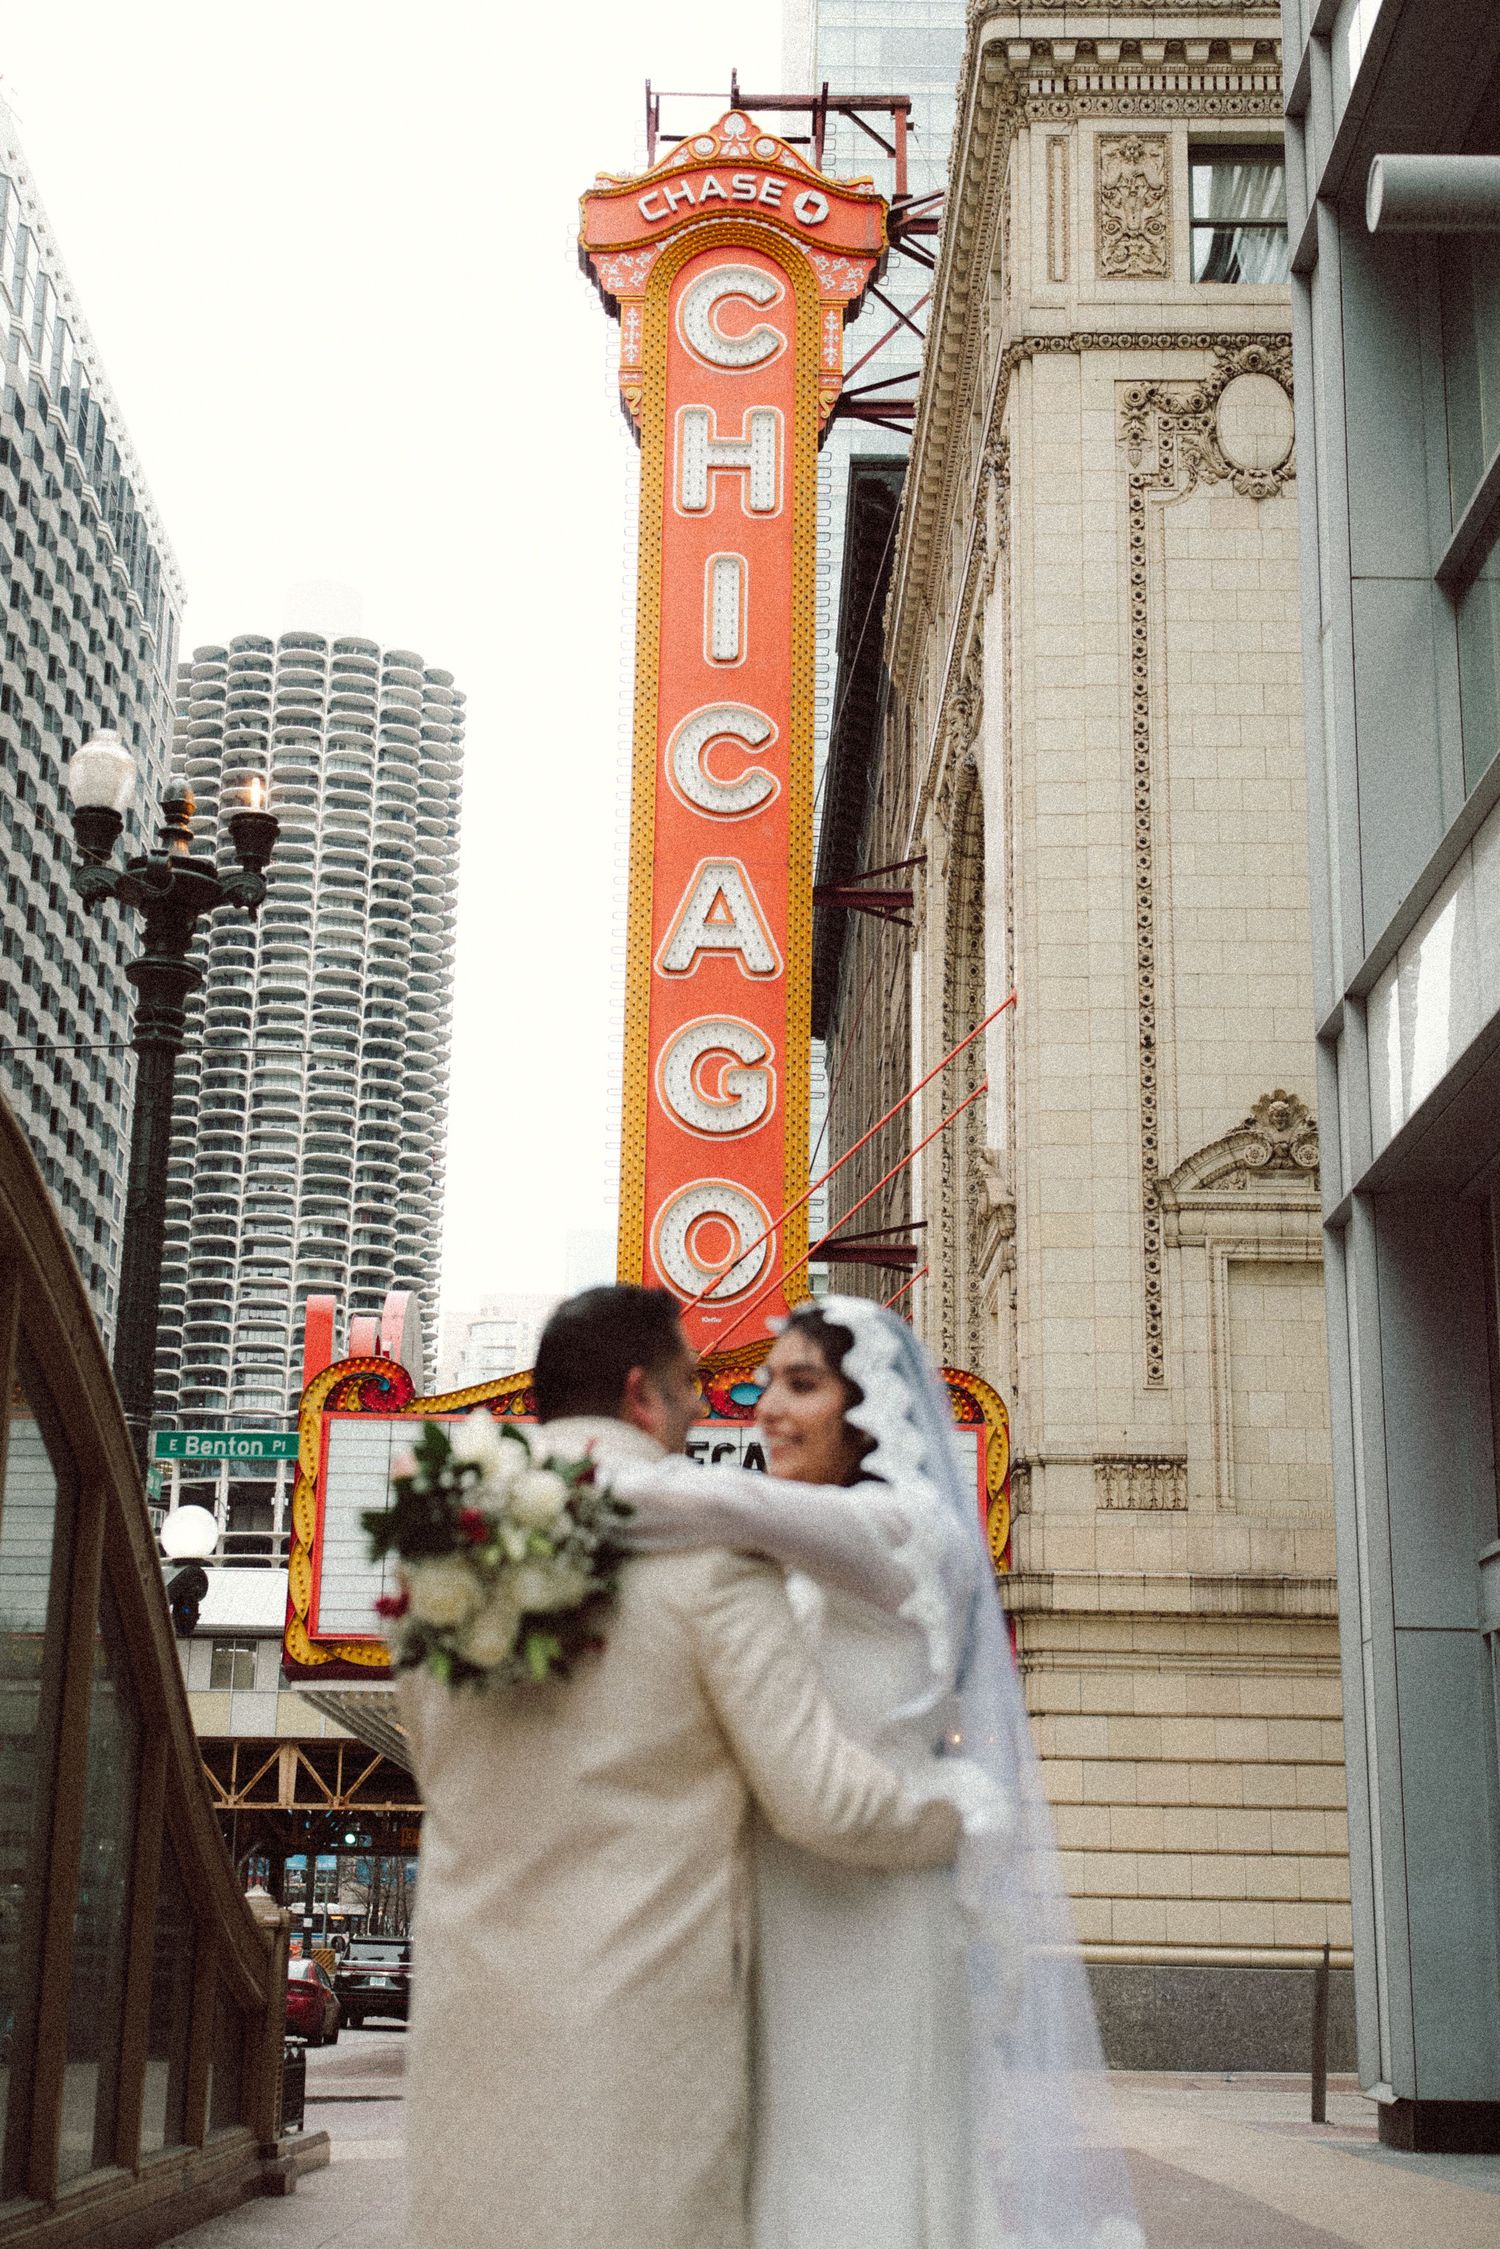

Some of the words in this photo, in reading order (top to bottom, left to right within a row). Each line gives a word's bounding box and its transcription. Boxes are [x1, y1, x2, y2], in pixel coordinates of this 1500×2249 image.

[638, 173, 788, 222] CHASE
[650, 262, 788, 1308] CHICAGO
[169, 1438, 179, 1452] E
[185, 1435, 264, 1457] Benton
[272, 1439, 287, 1453] Pl
